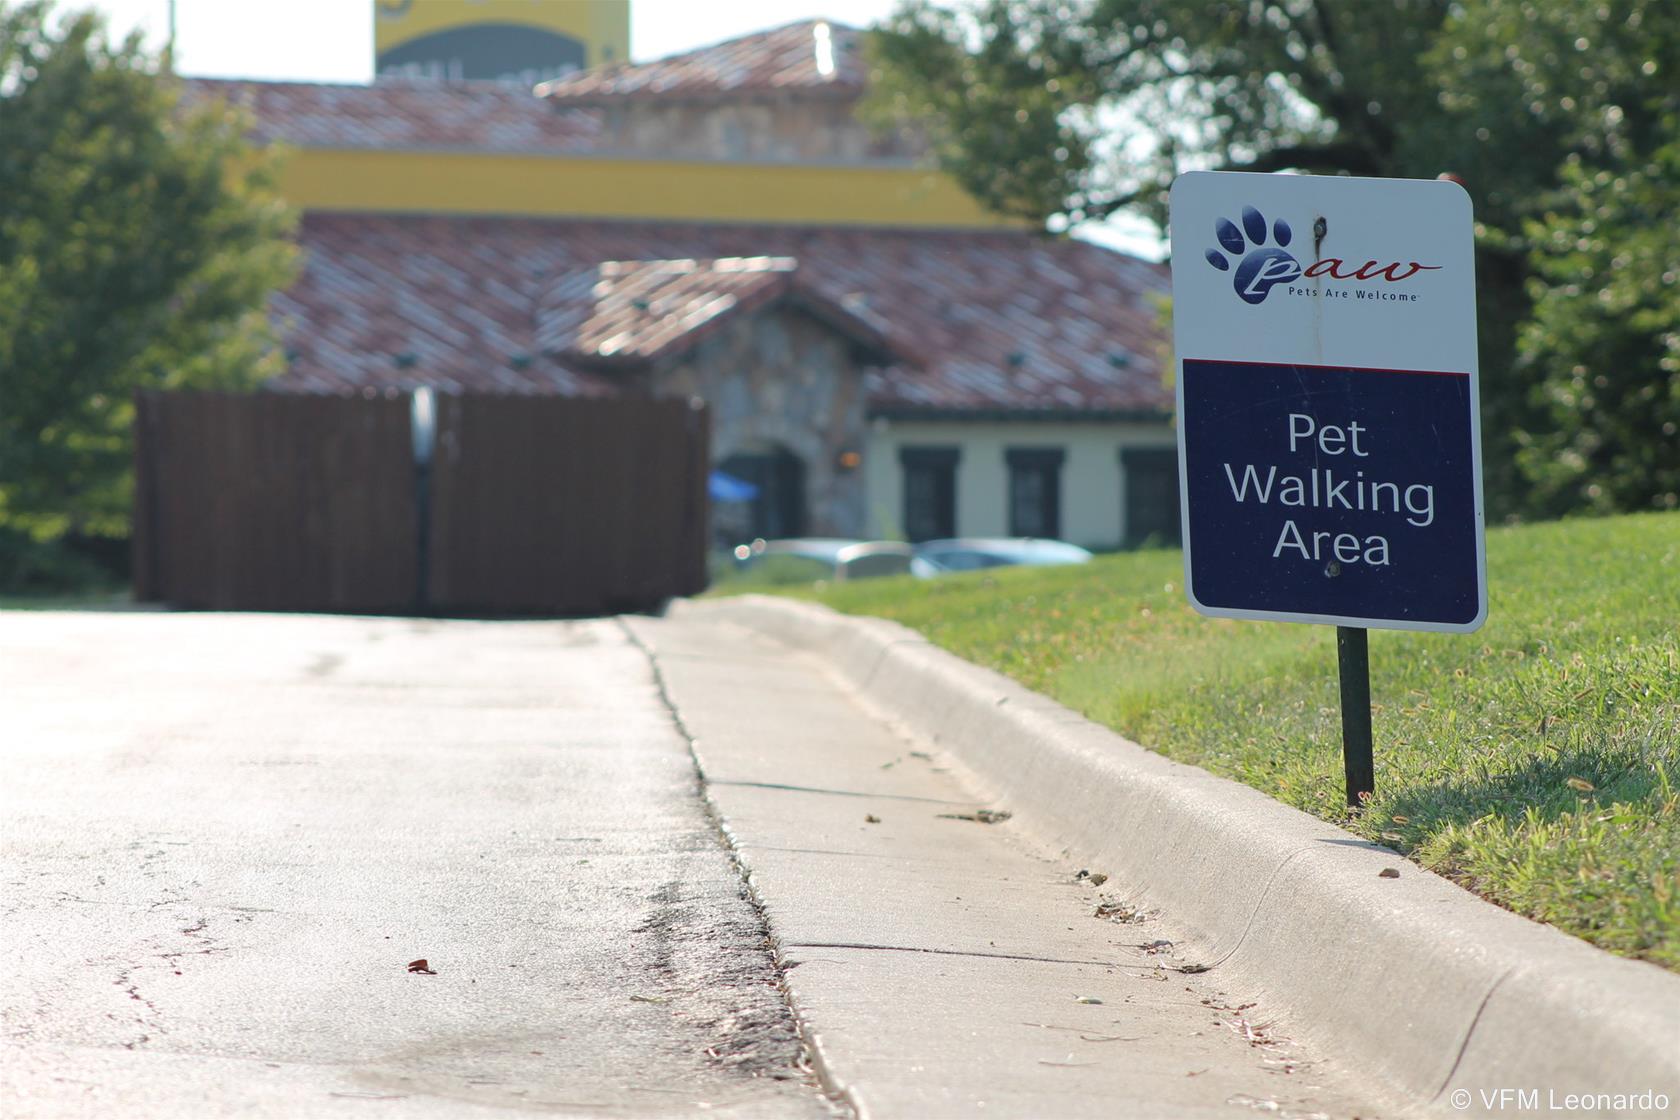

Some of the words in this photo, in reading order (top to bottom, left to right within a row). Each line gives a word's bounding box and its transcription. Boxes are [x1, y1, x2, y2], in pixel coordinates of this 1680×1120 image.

[1288, 286, 1318, 297] Pets
[1325, 287, 1348, 298] Are
[1355, 289, 1418, 302] Welcome
[1288, 413, 1369, 457] Pet
[1223, 463, 1434, 527] Walking
[1272, 519, 1390, 566] Area
